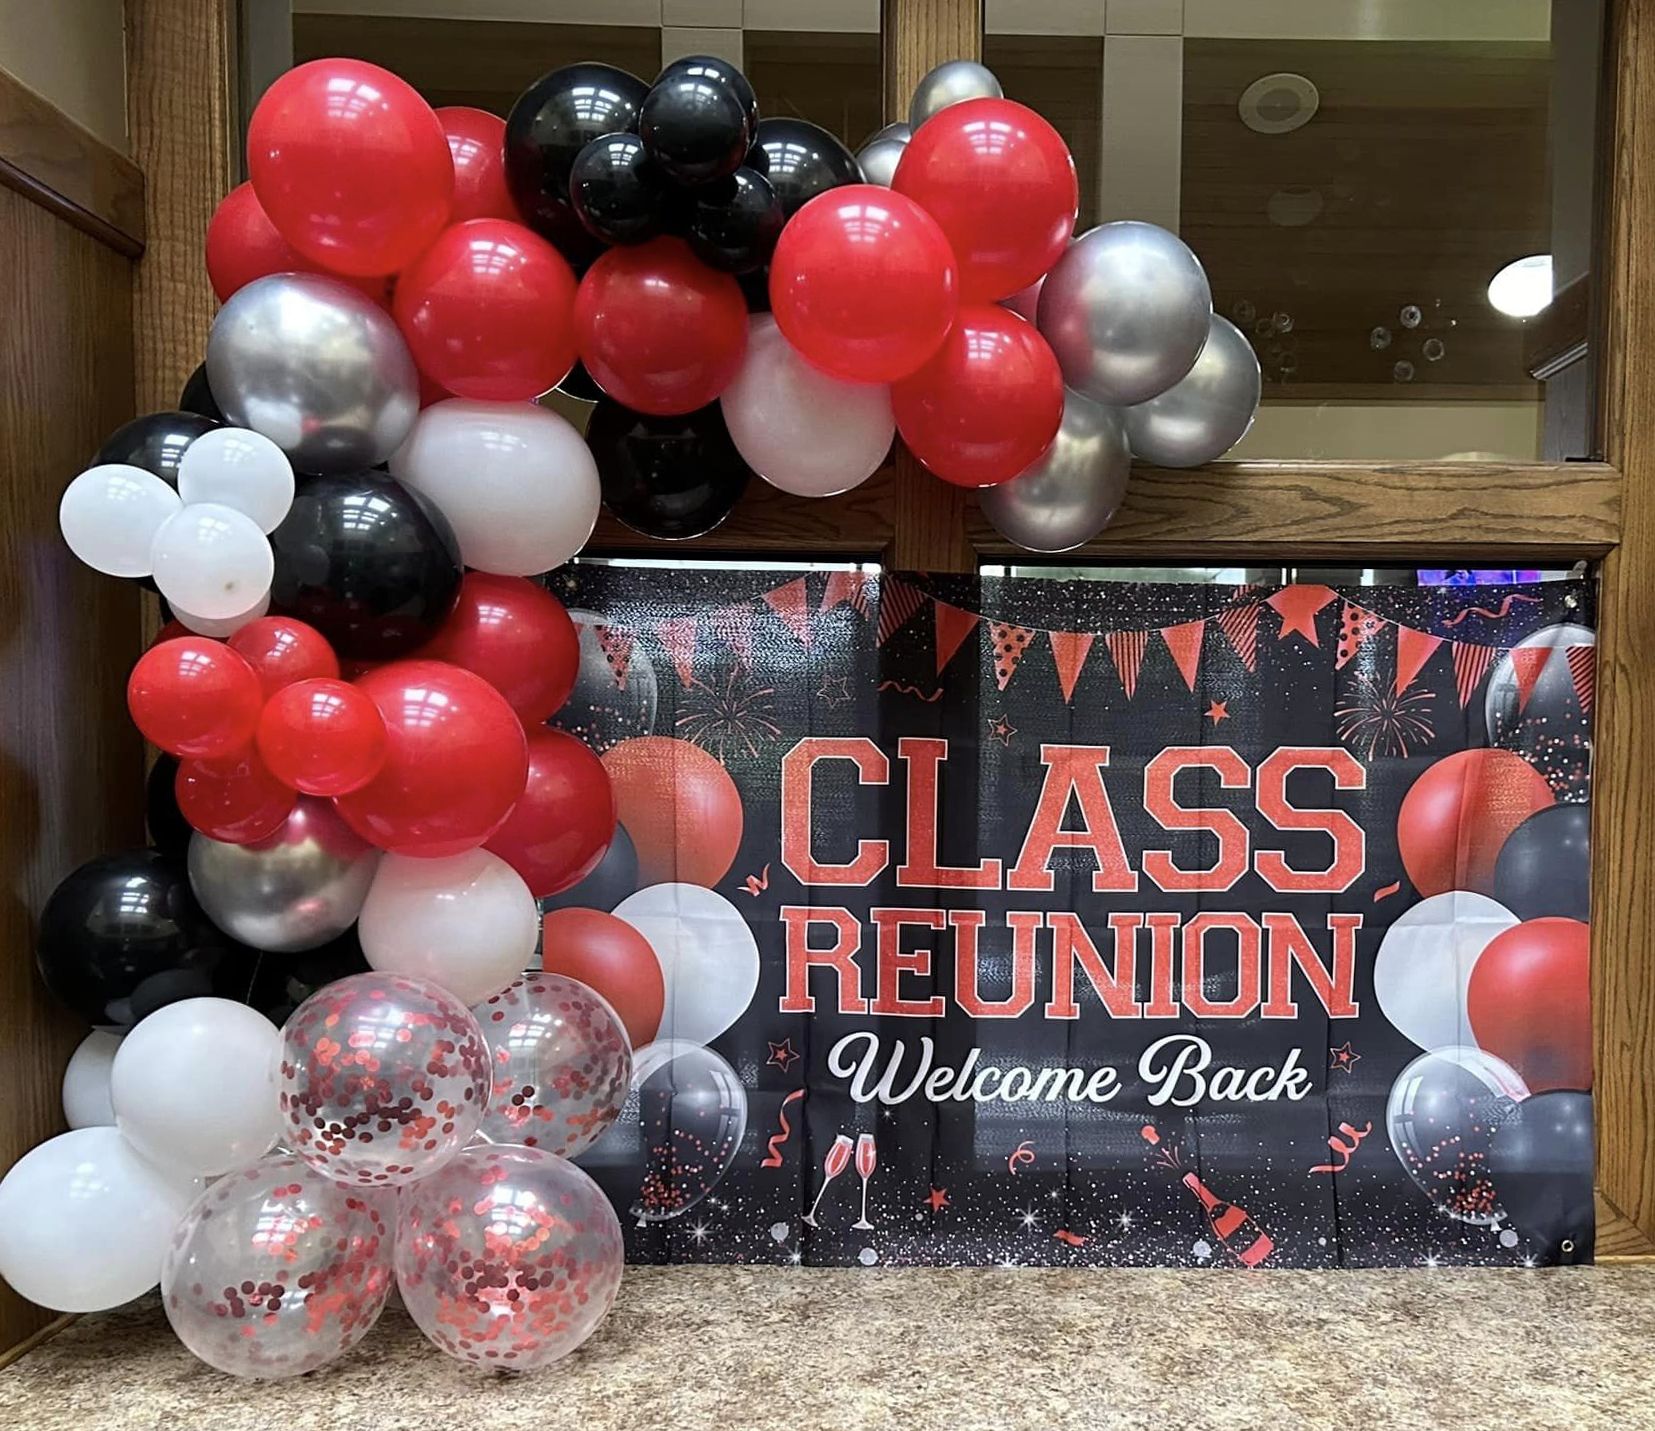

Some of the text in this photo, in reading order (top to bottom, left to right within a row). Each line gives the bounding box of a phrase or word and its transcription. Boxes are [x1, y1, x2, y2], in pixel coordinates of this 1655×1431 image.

[780, 736, 1368, 893] CLASS
[778, 905, 1365, 1020] REUNION
[827, 1032, 1314, 1107] Welcome Back
